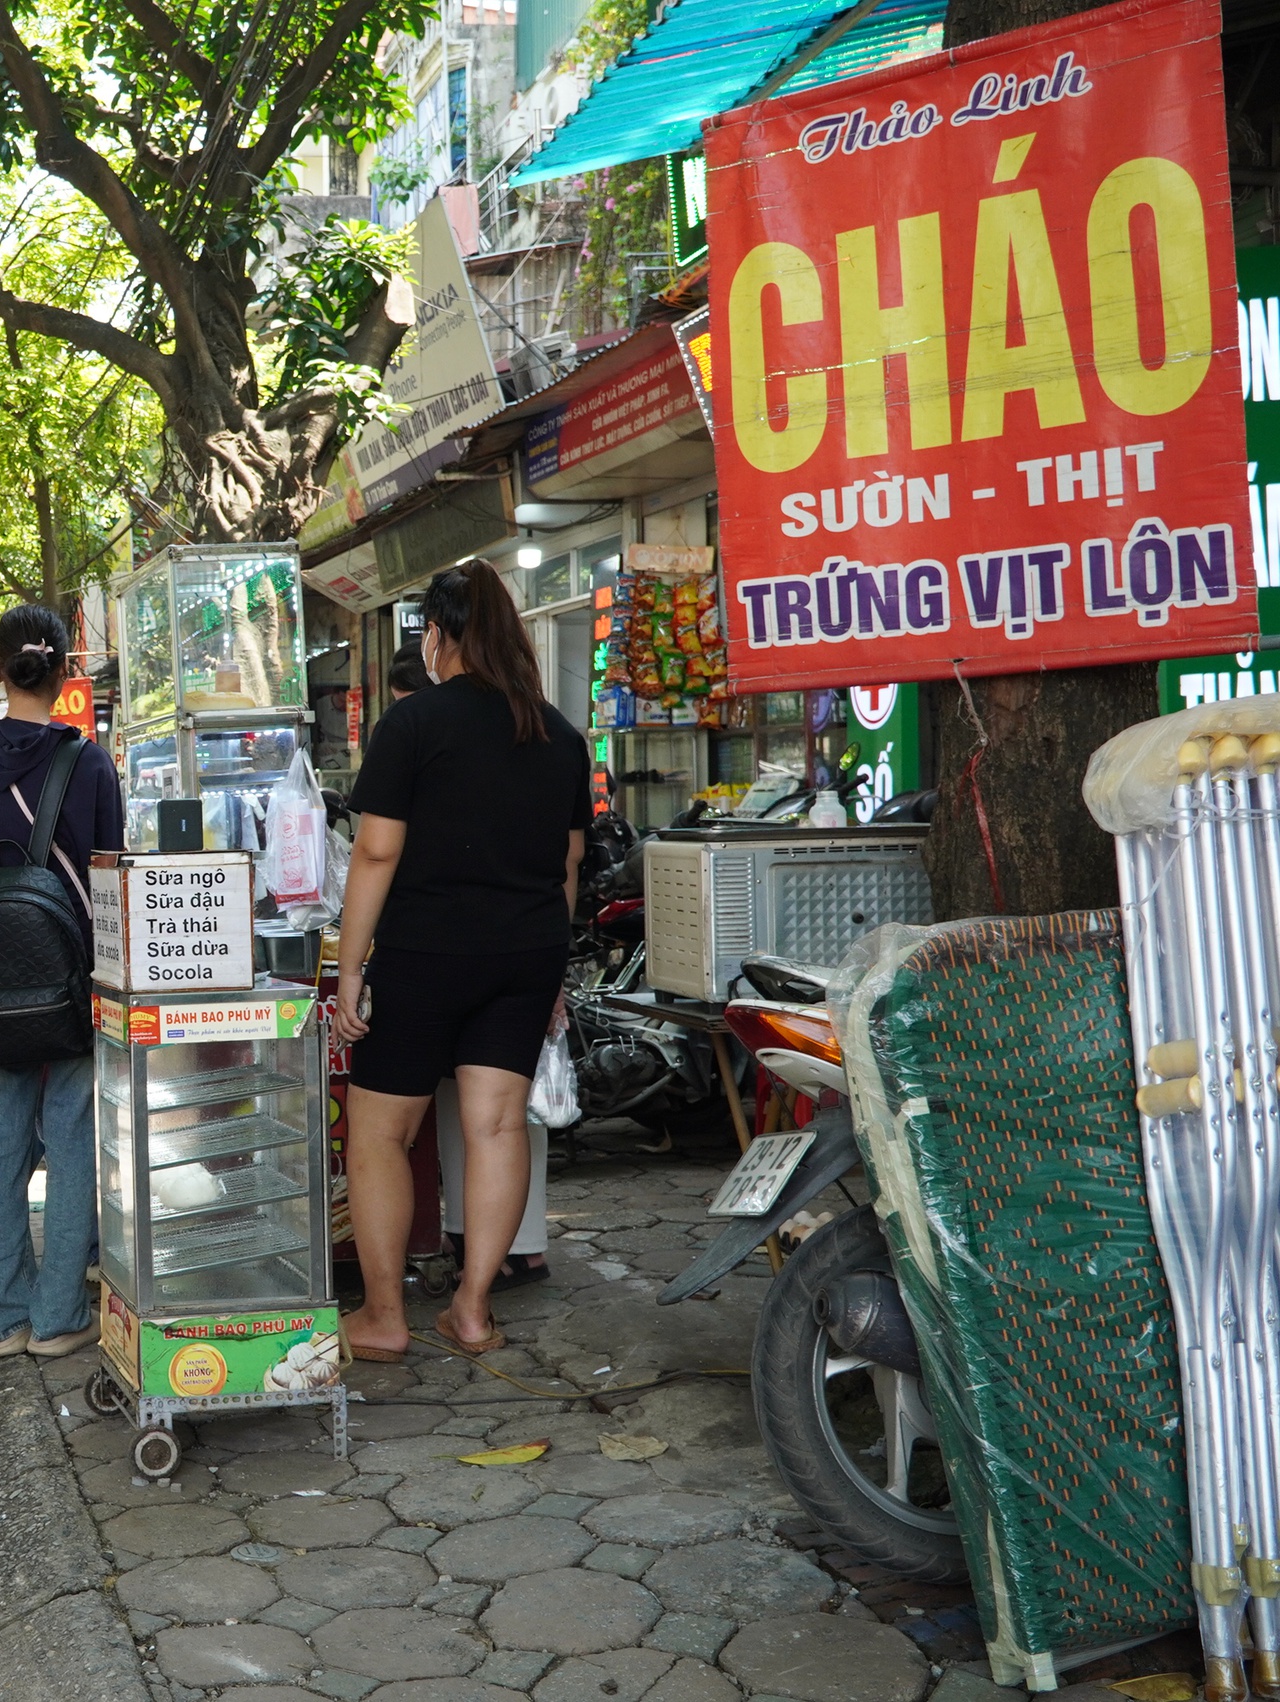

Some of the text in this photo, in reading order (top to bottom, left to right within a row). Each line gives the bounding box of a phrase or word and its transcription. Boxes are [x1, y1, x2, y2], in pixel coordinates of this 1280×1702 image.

[799, 51, 1092, 164] Thảo Linh
[416, 283, 460, 332] NOKIA
[729, 132, 1213, 473] CHÁO
[781, 471, 951, 538] SƯỜN
[1017, 441, 1165, 508] THỊT
[738, 556, 949, 649] TRỨNG
[958, 543, 1070, 641] VỊT
[1081, 516, 1237, 628] LỘN
[855, 741, 894, 824] SỐ
[145, 868, 226, 888] Sữa ngô
[145, 891, 225, 911] Sữa đậu
[146, 917, 218, 934] Trà thái
[147, 940, 229, 957] Sữa dừa
[148, 964, 213, 981] Socola
[166, 1006, 272, 1025] BÁNH BAO PHÚ MỸ
[741, 1136, 802, 1172] 29-Y2
[164, 1315, 315, 1340] BÁNH BAO PHÚ MỸ
[184, 1367, 211, 1377] KHÔNG
